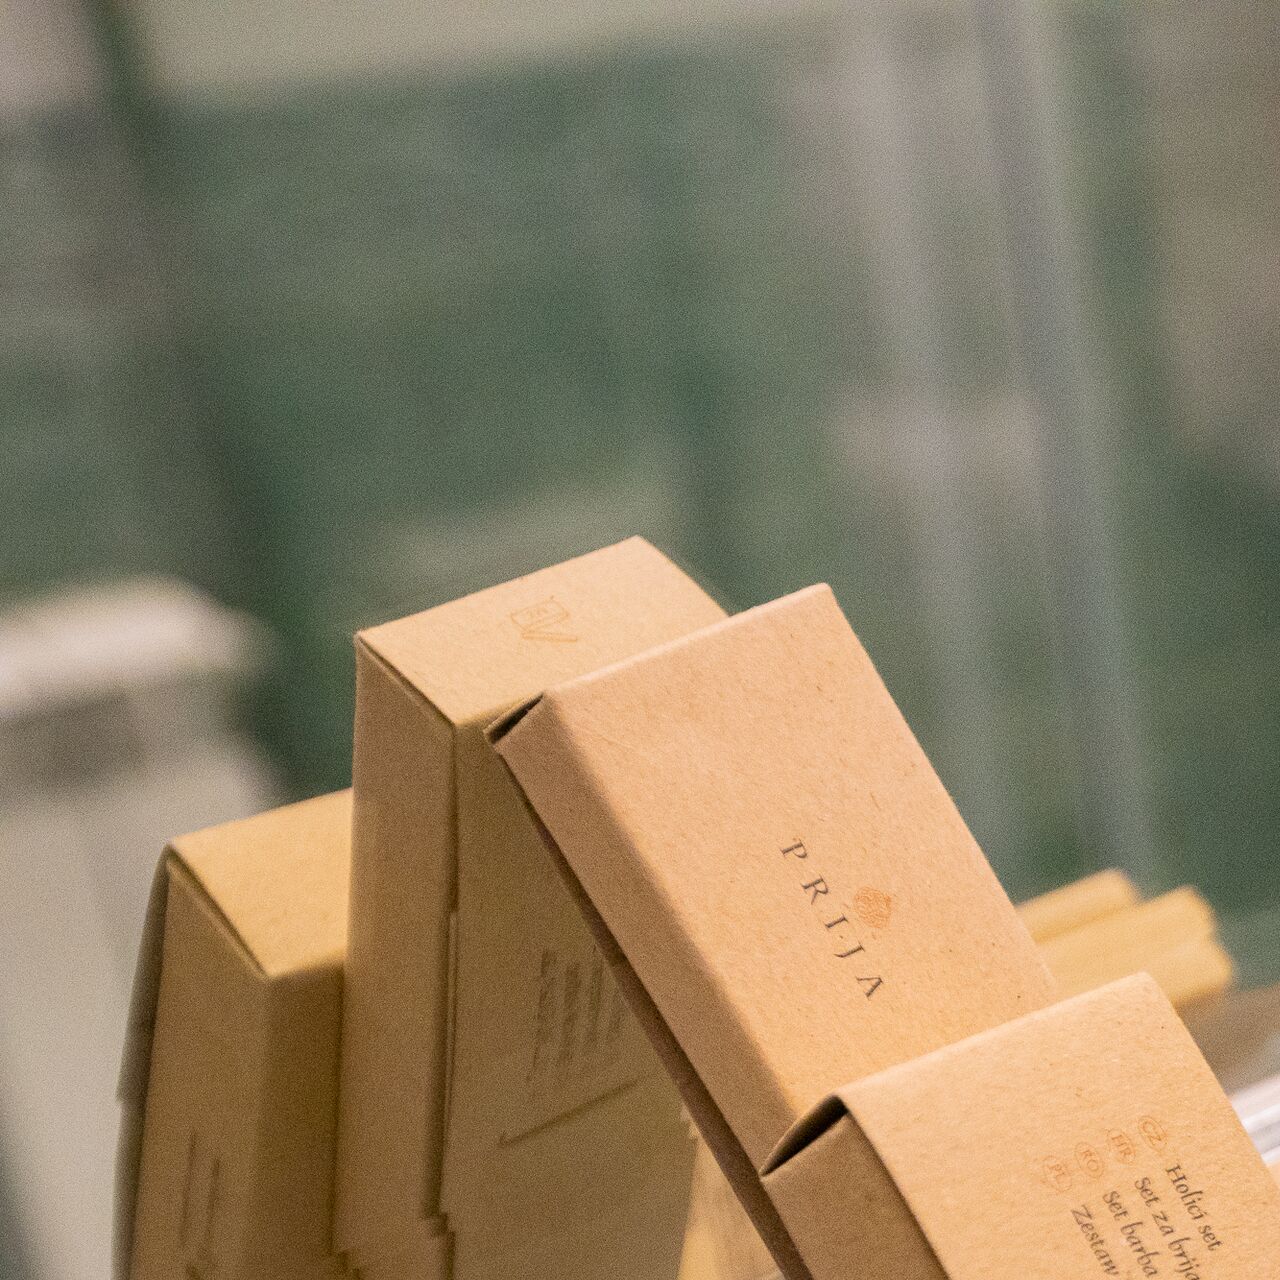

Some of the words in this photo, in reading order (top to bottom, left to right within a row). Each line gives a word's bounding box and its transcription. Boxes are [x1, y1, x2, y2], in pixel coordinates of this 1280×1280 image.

[780, 840, 884, 998] PRIJA
[1071, 1204, 1119, 1277] Zestaw
[1081, 1148, 1102, 1173] RO
[1102, 1190, 1129, 1222] Set
[1121, 1221, 1159, 1279] barba
[1111, 1132, 1133, 1158] HR
[1134, 1176, 1160, 1208] Set
[1152, 1210, 1174, 1237] za
[1141, 1120, 1164, 1145] CZ
[1198, 1224, 1224, 1252] set
